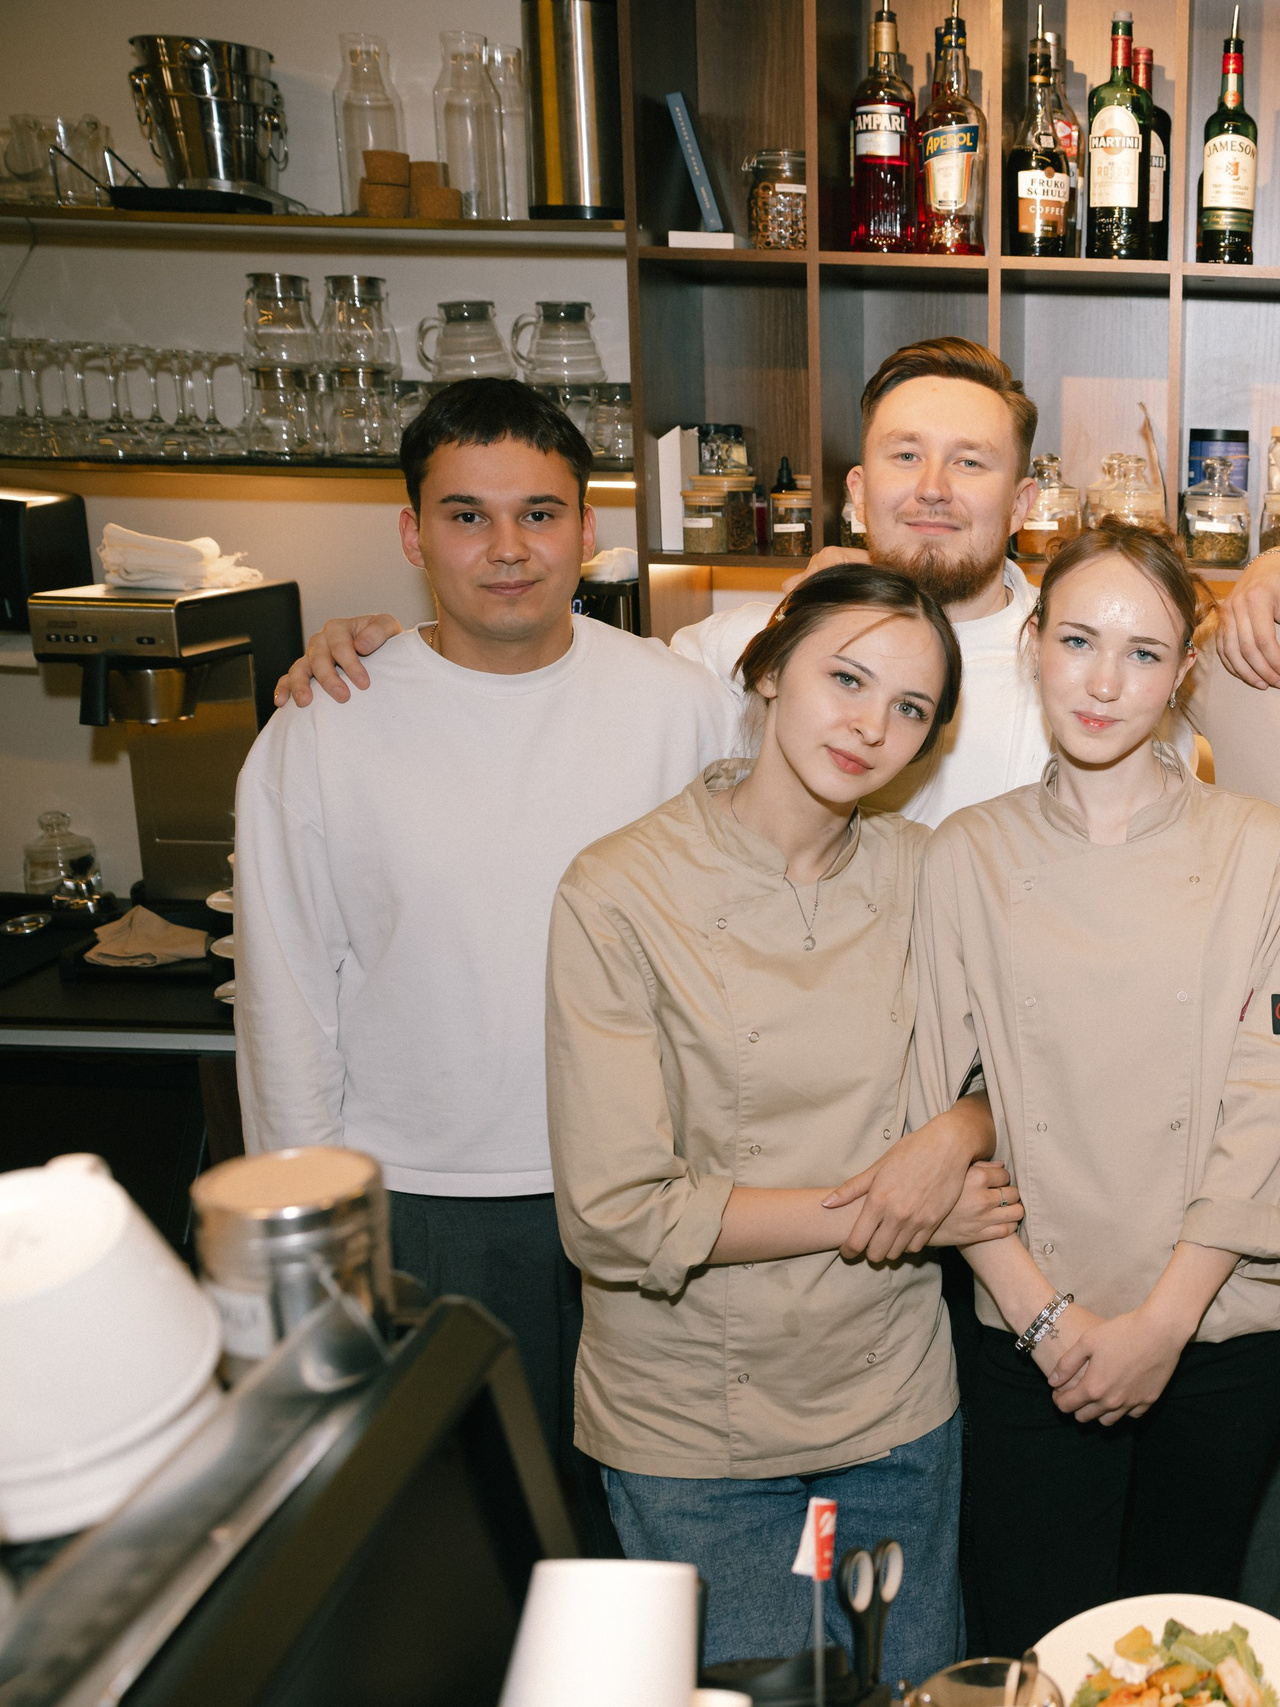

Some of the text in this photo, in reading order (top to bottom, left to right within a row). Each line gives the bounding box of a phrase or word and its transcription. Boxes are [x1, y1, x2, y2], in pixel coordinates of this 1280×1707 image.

[855, 113, 906, 132] AMPARI
[926, 132, 973, 156] APEROL
[1091, 136, 1139, 149] MARTINI
[1207, 140, 1257, 160] JAMESON
[1030, 178, 1066, 189] FRUKO
